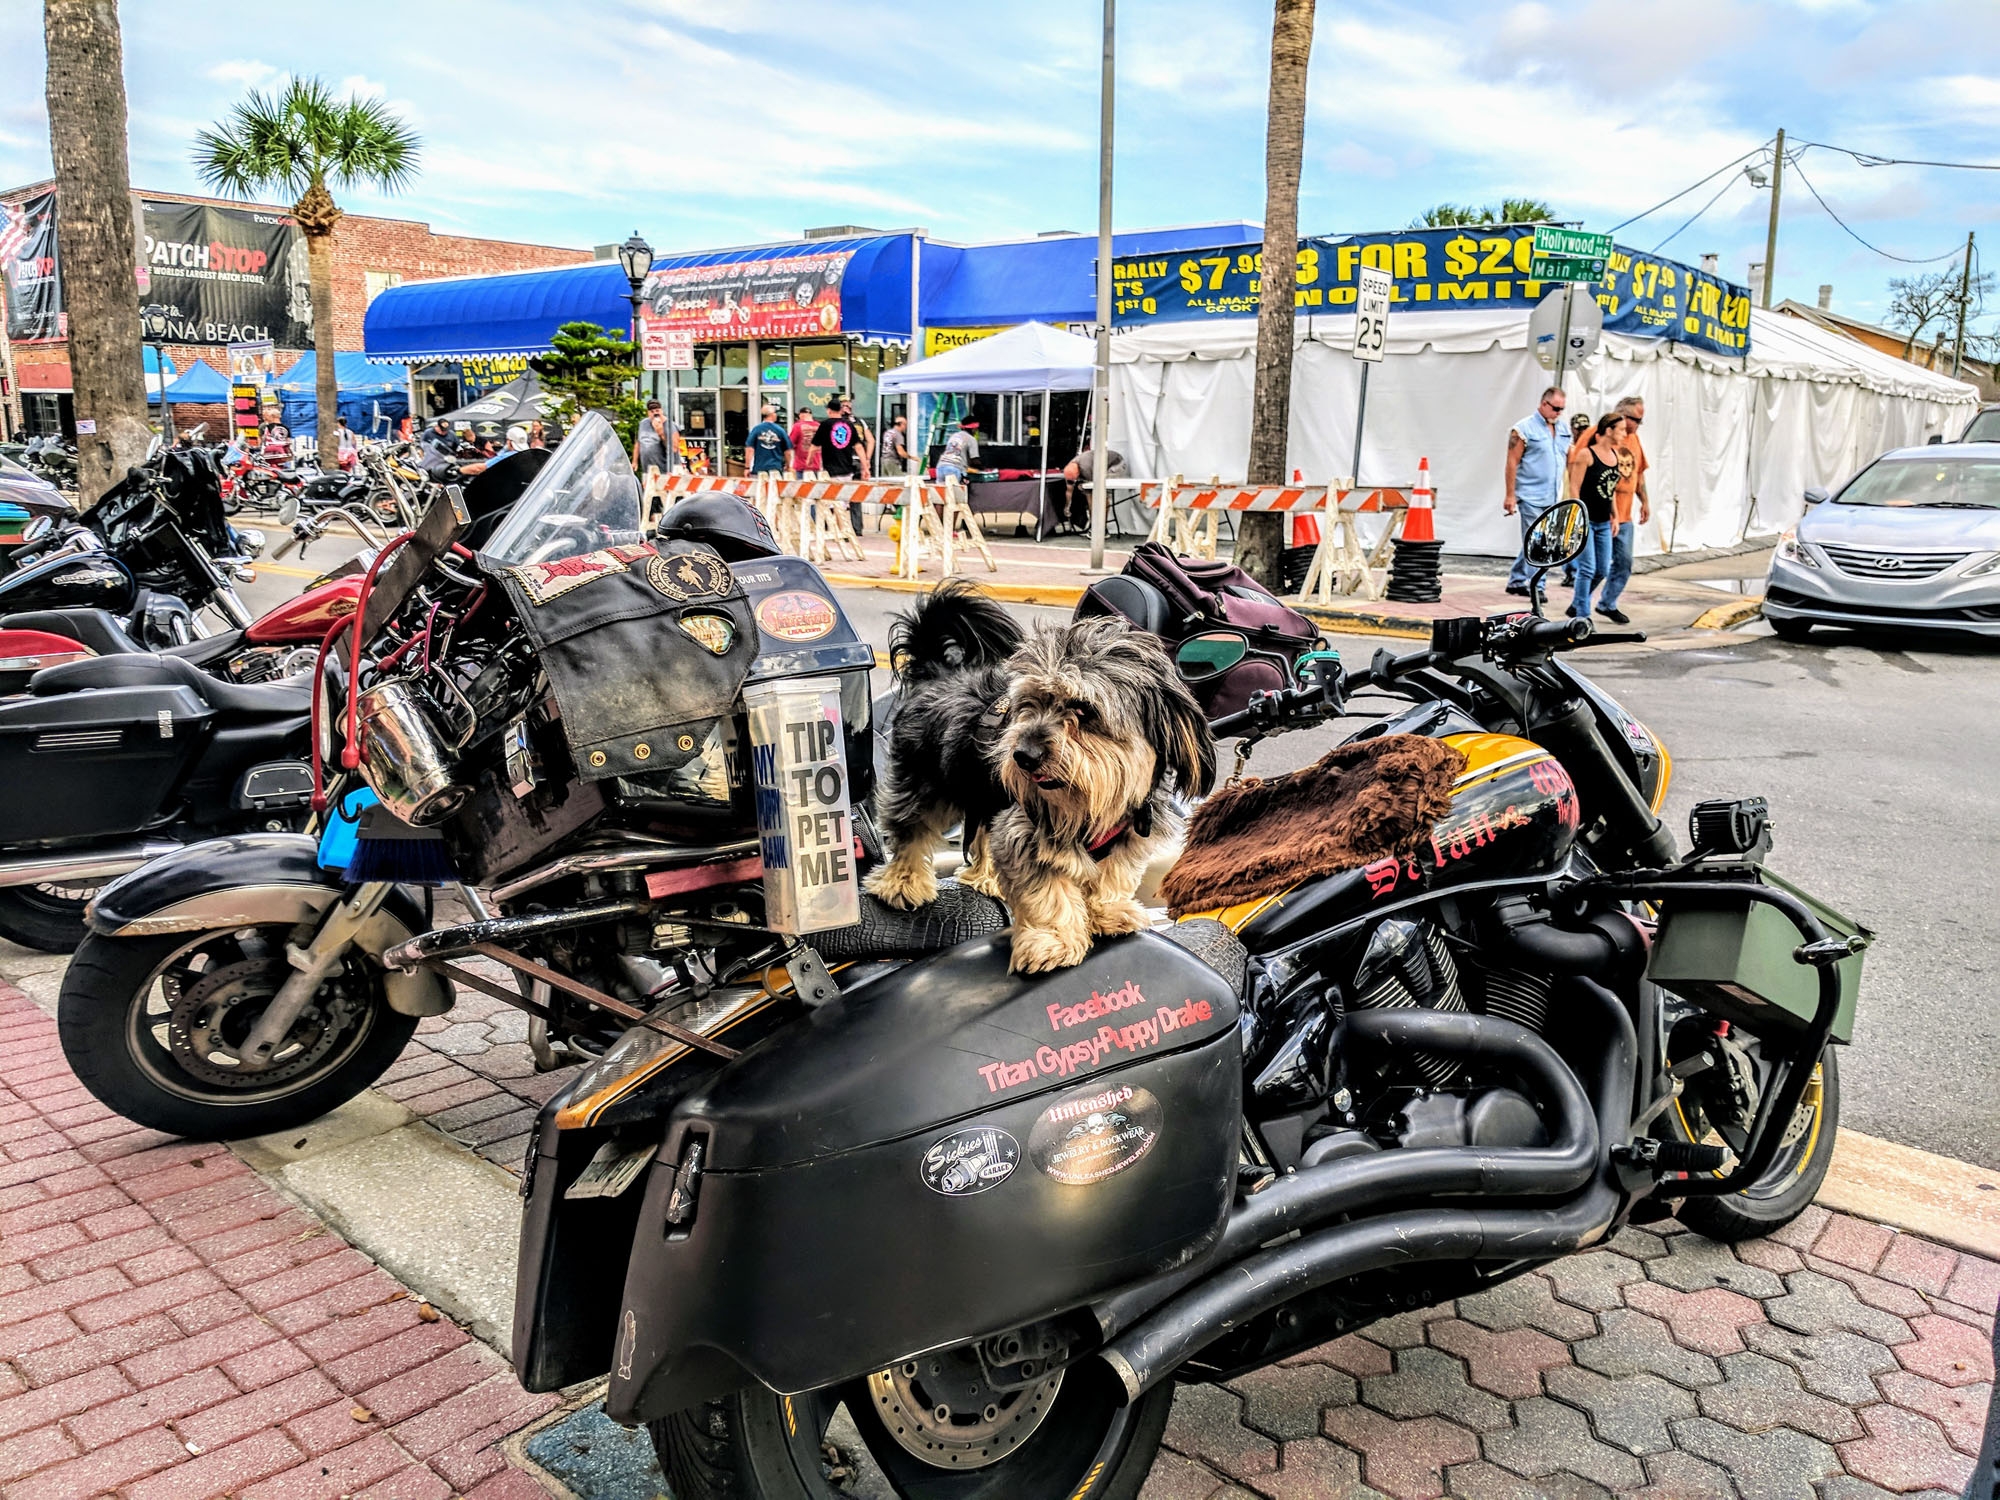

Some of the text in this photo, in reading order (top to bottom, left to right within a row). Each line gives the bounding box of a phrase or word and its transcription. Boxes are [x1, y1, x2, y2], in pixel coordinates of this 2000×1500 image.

[1541, 230, 1595, 253] Hollywood
[1296, 242, 1428, 284] 3 FOR
[1445, 235, 1545, 280] $20
[1534, 261, 1590, 277] Main St
[153, 267, 184, 278] WORLDS
[186, 270, 216, 281] LARGEST
[218, 272, 240, 282] PATCH
[1113, 262, 1168, 280] RALLY
[1114, 282, 1144, 297] T'S
[1295, 280, 1549, 307] NO LIMIT
[1363, 278, 1388, 296] SPEED
[1115, 298, 1156, 315] 1ST Q
[1187, 296, 1260, 308] ALL MAJO
[1205, 303, 1252, 314] CC OK
[1364, 298, 1384, 314] LIMIT
[206, 322, 268, 343] BEACH
[935, 333, 984, 346] Patche
[1358, 317, 1383, 350] 25
[1706, 322, 1745, 348] LIMIT
[765, 366, 789, 380] OPEN
[735, 573, 772, 585] OUR TITS
[786, 720, 835, 763] TIP
[754, 743, 776, 785] MY
[792, 766, 841, 808] TO
[797, 810, 845, 848] PET
[762, 836, 788, 869] BANK
[801, 849, 849, 888] ME
[1046, 980, 1146, 1031] Facebook
[978, 999, 1212, 1093] Titan Gypsy-Puppy Drake
[1047, 1085, 1133, 1122] Unleashed
[927, 1137, 983, 1173] Sickies
[1052, 1127, 1146, 1164] JEWELRY & ROCKWEAR
[983, 1164, 1010, 1176] GARAGE
